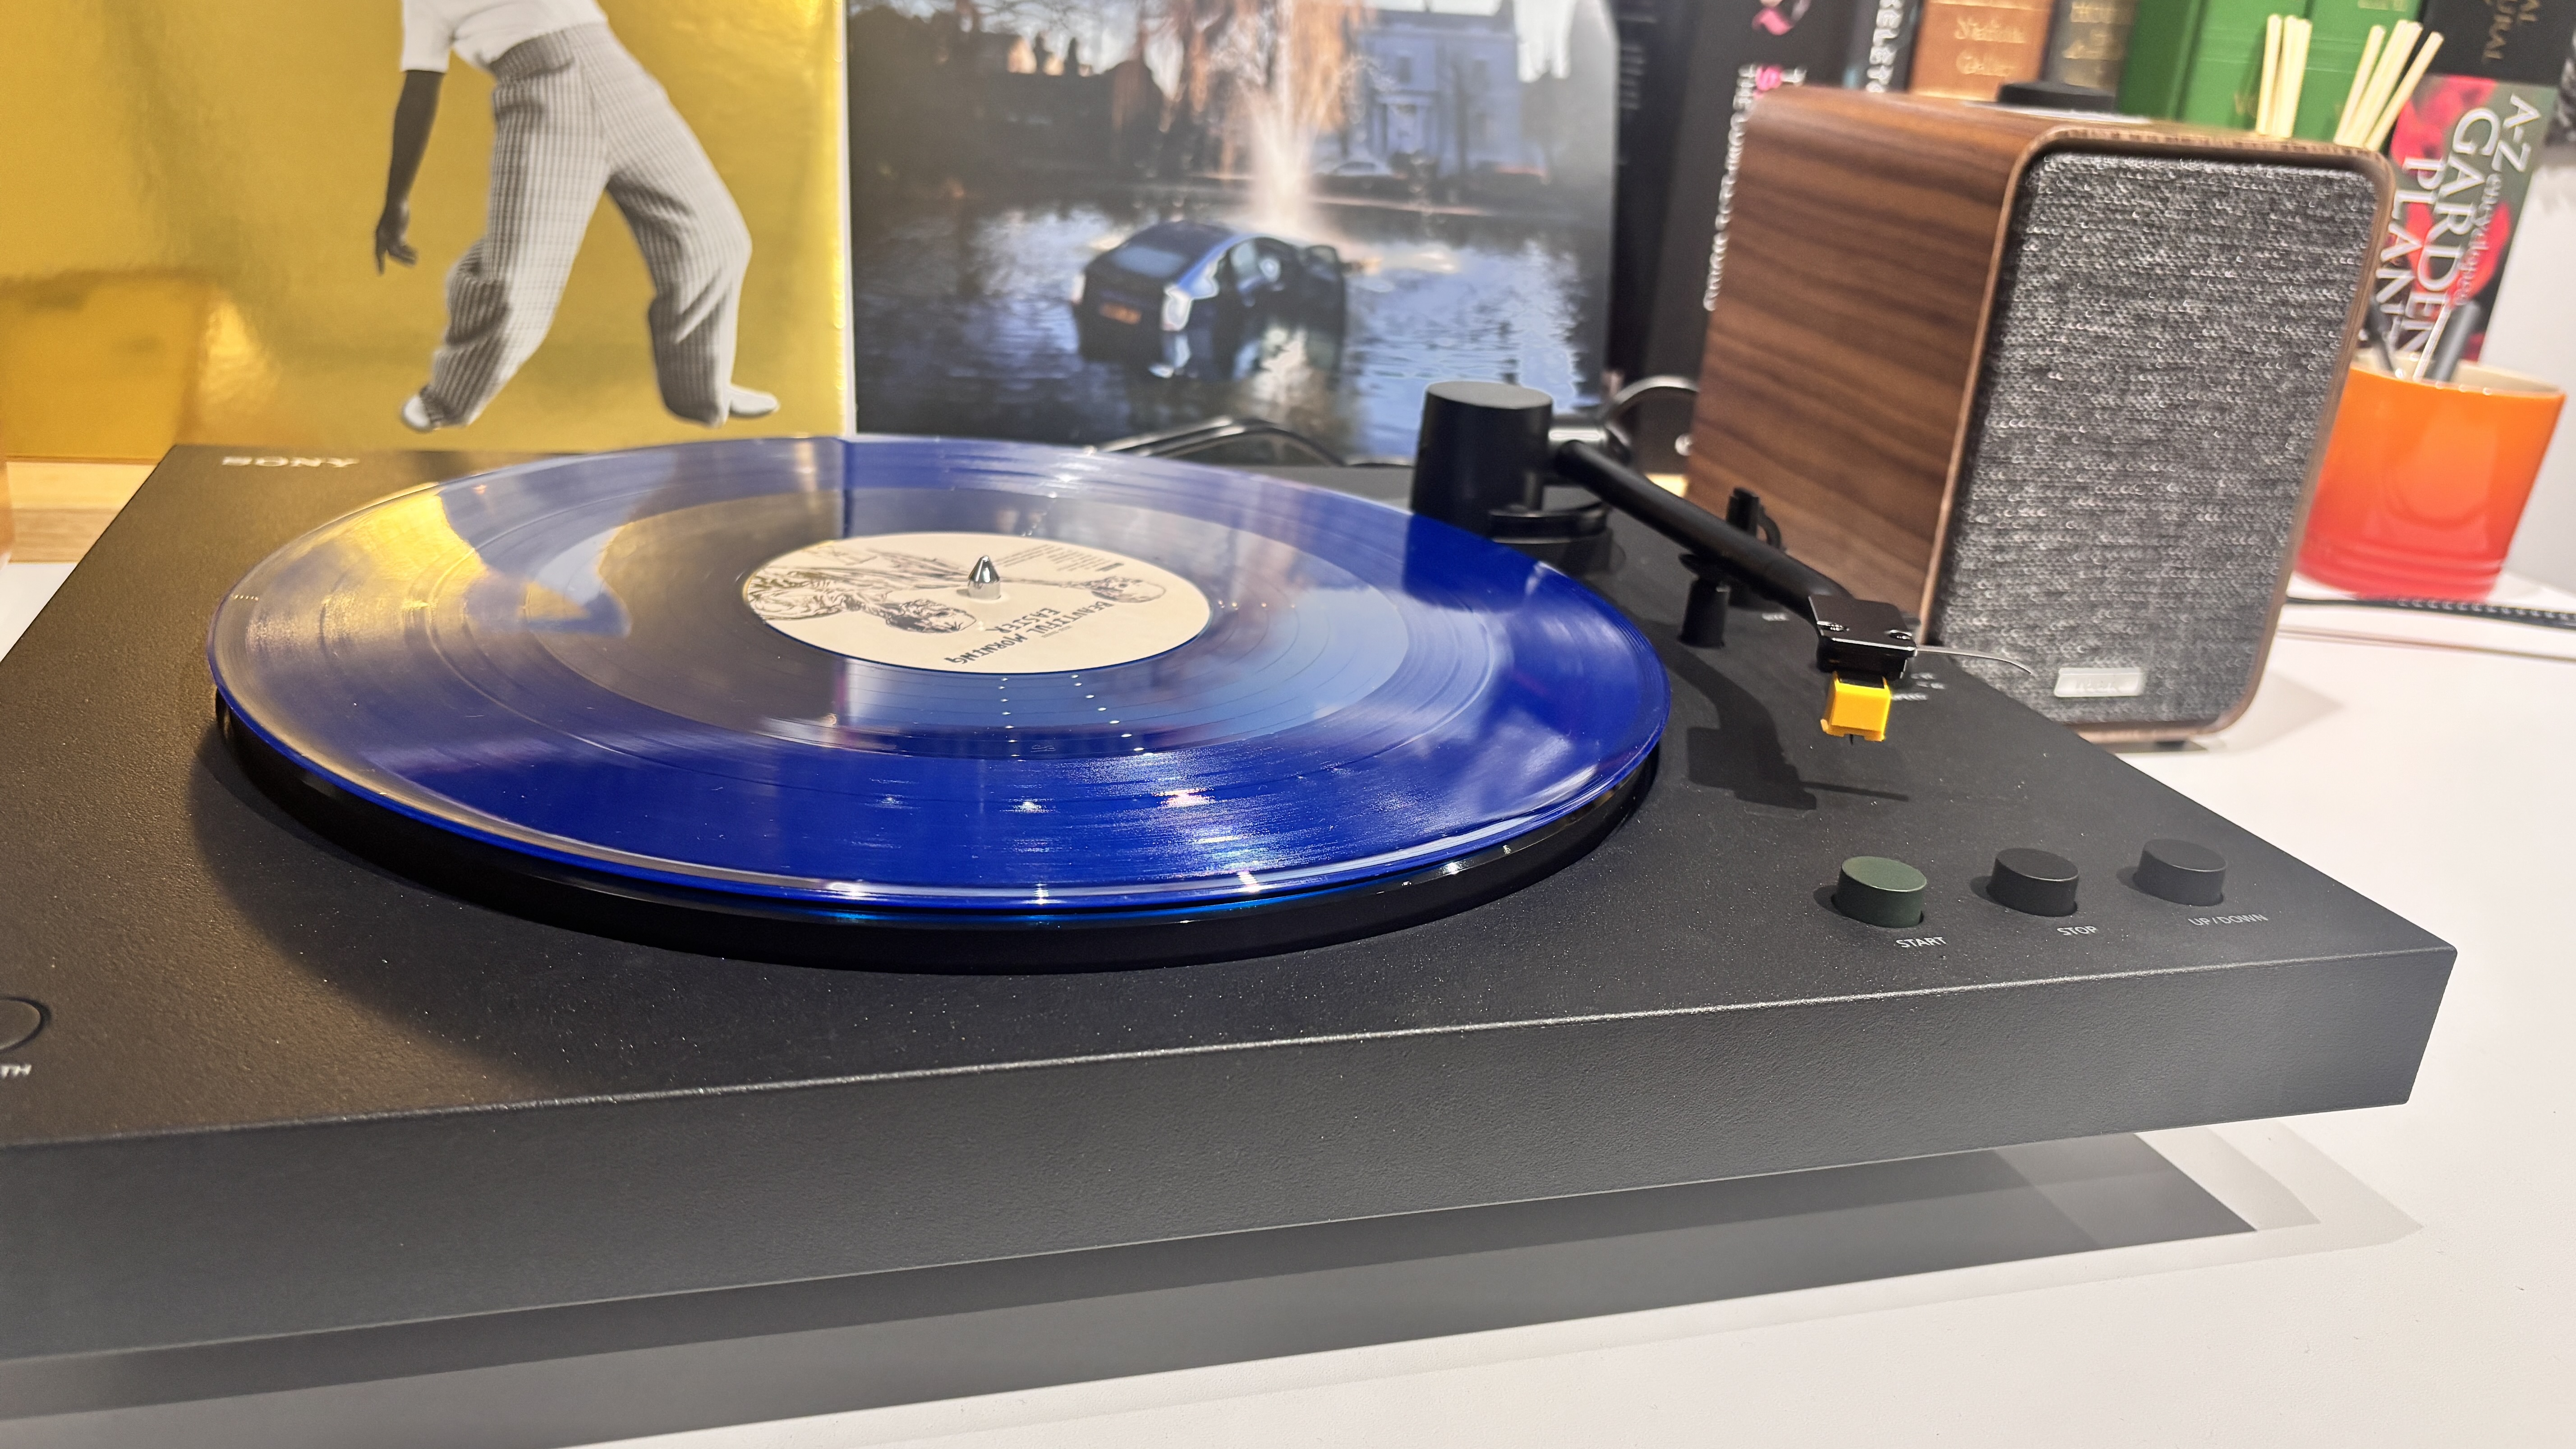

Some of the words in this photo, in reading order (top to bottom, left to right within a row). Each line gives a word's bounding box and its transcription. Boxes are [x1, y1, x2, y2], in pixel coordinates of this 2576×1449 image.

[2492, 93, 2542, 172] A-Z
[221, 456, 360, 467] SONY
[985, 607, 1061, 634] EASIER
[1026, 600, 1115, 634] BEAUTIFUL
[944, 633, 1028, 664] MORNING
[1896, 937, 1947, 948] START
[2057, 926, 2098, 936] STOP
